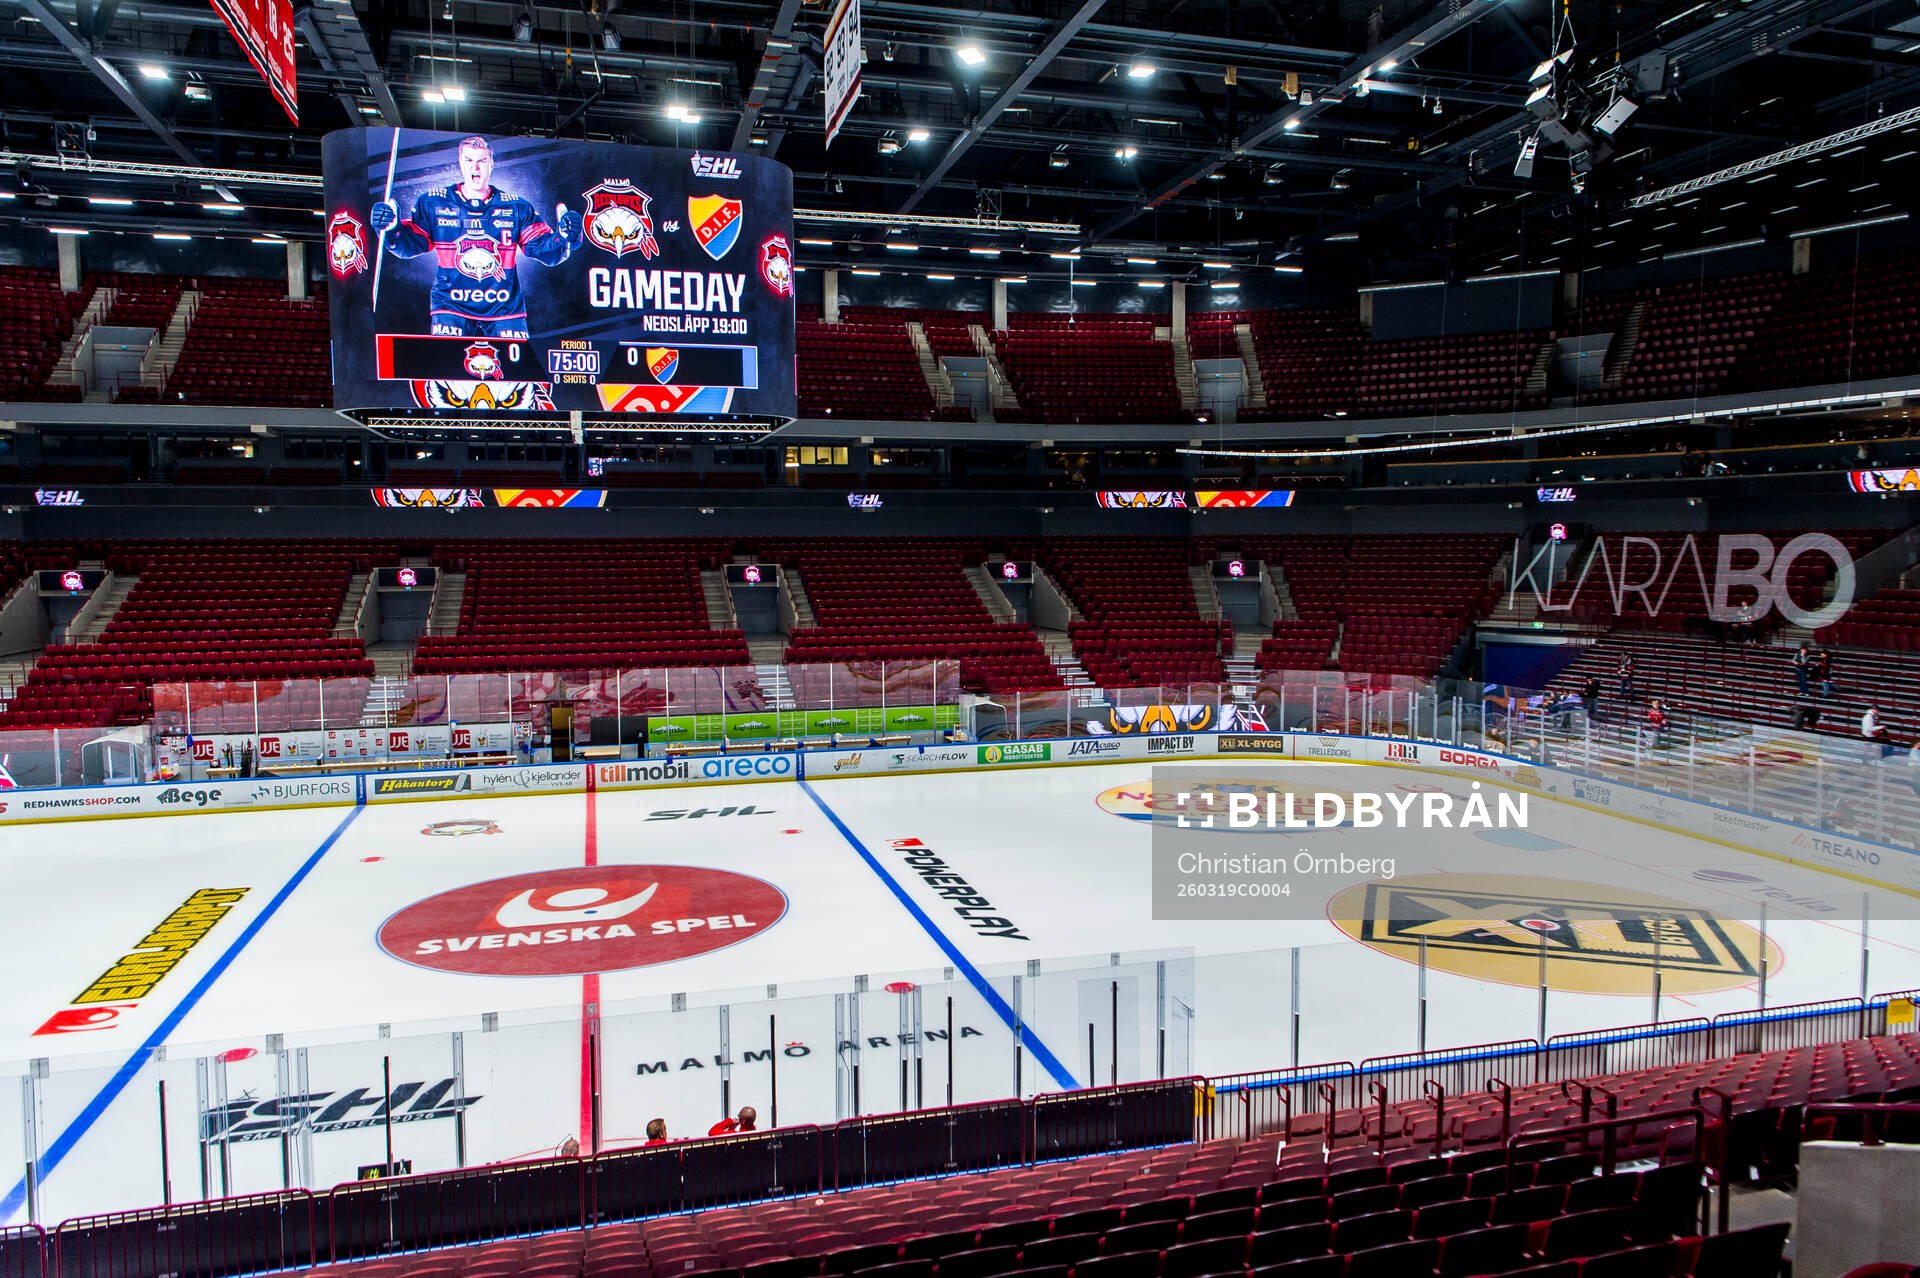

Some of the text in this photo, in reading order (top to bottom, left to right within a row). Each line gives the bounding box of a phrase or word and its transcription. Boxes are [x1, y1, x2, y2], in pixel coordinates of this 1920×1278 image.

[699, 157, 742, 174] SHL
[604, 178, 630, 187] MALMÖ
[663, 220, 680, 232] vs
[700, 206, 737, 239] D.I.F.
[503, 229, 512, 246] C
[450, 288, 510, 303] areco
[589, 267, 746, 313] GAMEDAY
[643, 313, 748, 334] NEDSLÄPP 19:00
[509, 343, 520, 362] 0
[561, 340, 592, 350] PERIOD 1
[553, 352, 597, 372] 75:00
[627, 347, 638, 366] 0
[554, 374, 596, 385] 0 SHOTS 0
[42, 490, 85, 503] SHL
[852, 494, 884, 505] SHL
[1543, 487, 1577, 499] SHL
[1508, 532, 1856, 629] KLARABO
[260, 741, 280, 753] JJE
[390, 736, 409, 748] JJE
[1003, 743, 1044, 755] GASAB
[1068, 740, 1100, 755] JATA
[1148, 736, 1195, 750] IMPACT BY
[1221, 740, 1281, 748] XL XL-BYGG
[194, 744, 214, 757] JJE
[906, 752, 968, 763] SEARCHFLOW
[1308, 747, 1352, 758] TRELLEBORG
[702, 756, 791, 778] areco
[1439, 749, 1500, 772] BORGA
[531, 770, 582, 784] kjellander
[600, 760, 689, 783] tillmobil
[274, 781, 350, 798] BJURFORS
[380, 776, 454, 793] Håkantorp
[24, 796, 141, 809] REDHAWKSSHOP.COM
[1713, 811, 1770, 833] ticketmaster
[1811, 837, 1881, 866] TREANO
[895, 847, 1029, 941] POWERPLAY
[1751, 885, 1838, 913] Telia
[415, 913, 756, 956] SVENSKA SPEL
[837, 1026, 984, 1053] ARENA
[390, 1111, 436, 1126] 2026
